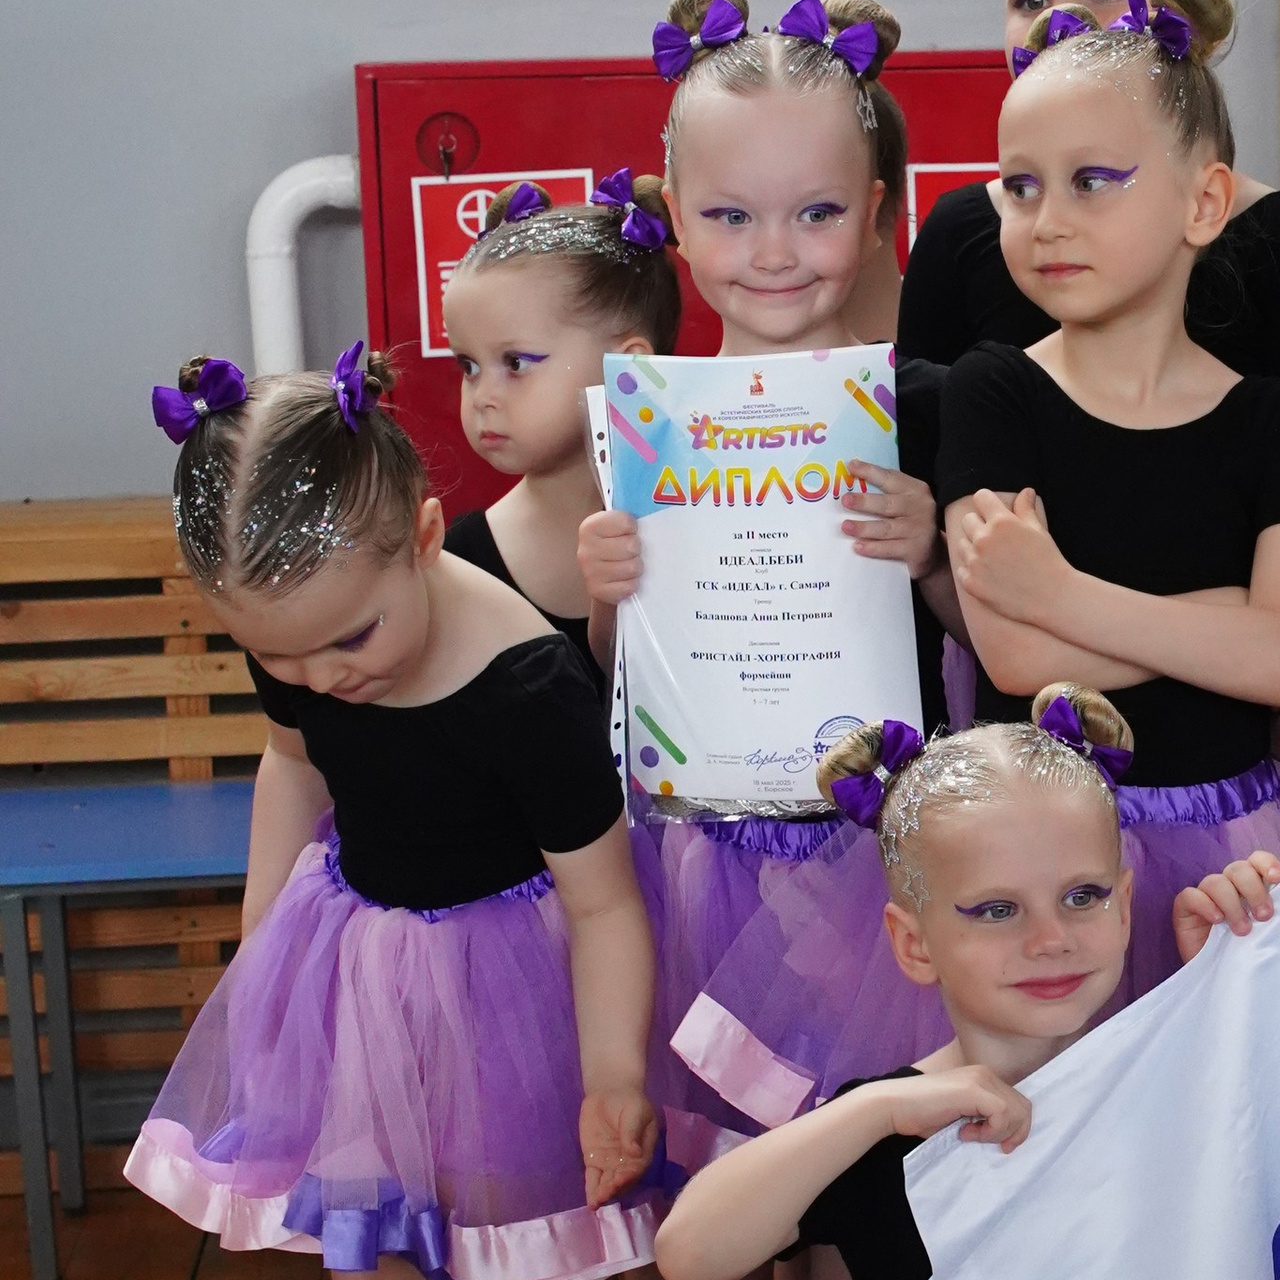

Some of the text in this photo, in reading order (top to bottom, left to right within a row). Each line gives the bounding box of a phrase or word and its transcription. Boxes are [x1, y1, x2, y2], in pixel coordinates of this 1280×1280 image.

[687, 414, 828, 451] ARTISTIC
[652, 458, 868, 507] ДИПЛОМ
[732, 532, 743, 540] за
[758, 531, 789, 540] место
[719, 554, 804, 567] ИДЕАЛ.БЕБИ
[695, 580, 831, 594] ТСК «ИДЕАЛ» г. Самара
[695, 610, 833, 622] Балашова Анна Петровна
[690, 651, 751, 662] ФРИСТАЙЛ
